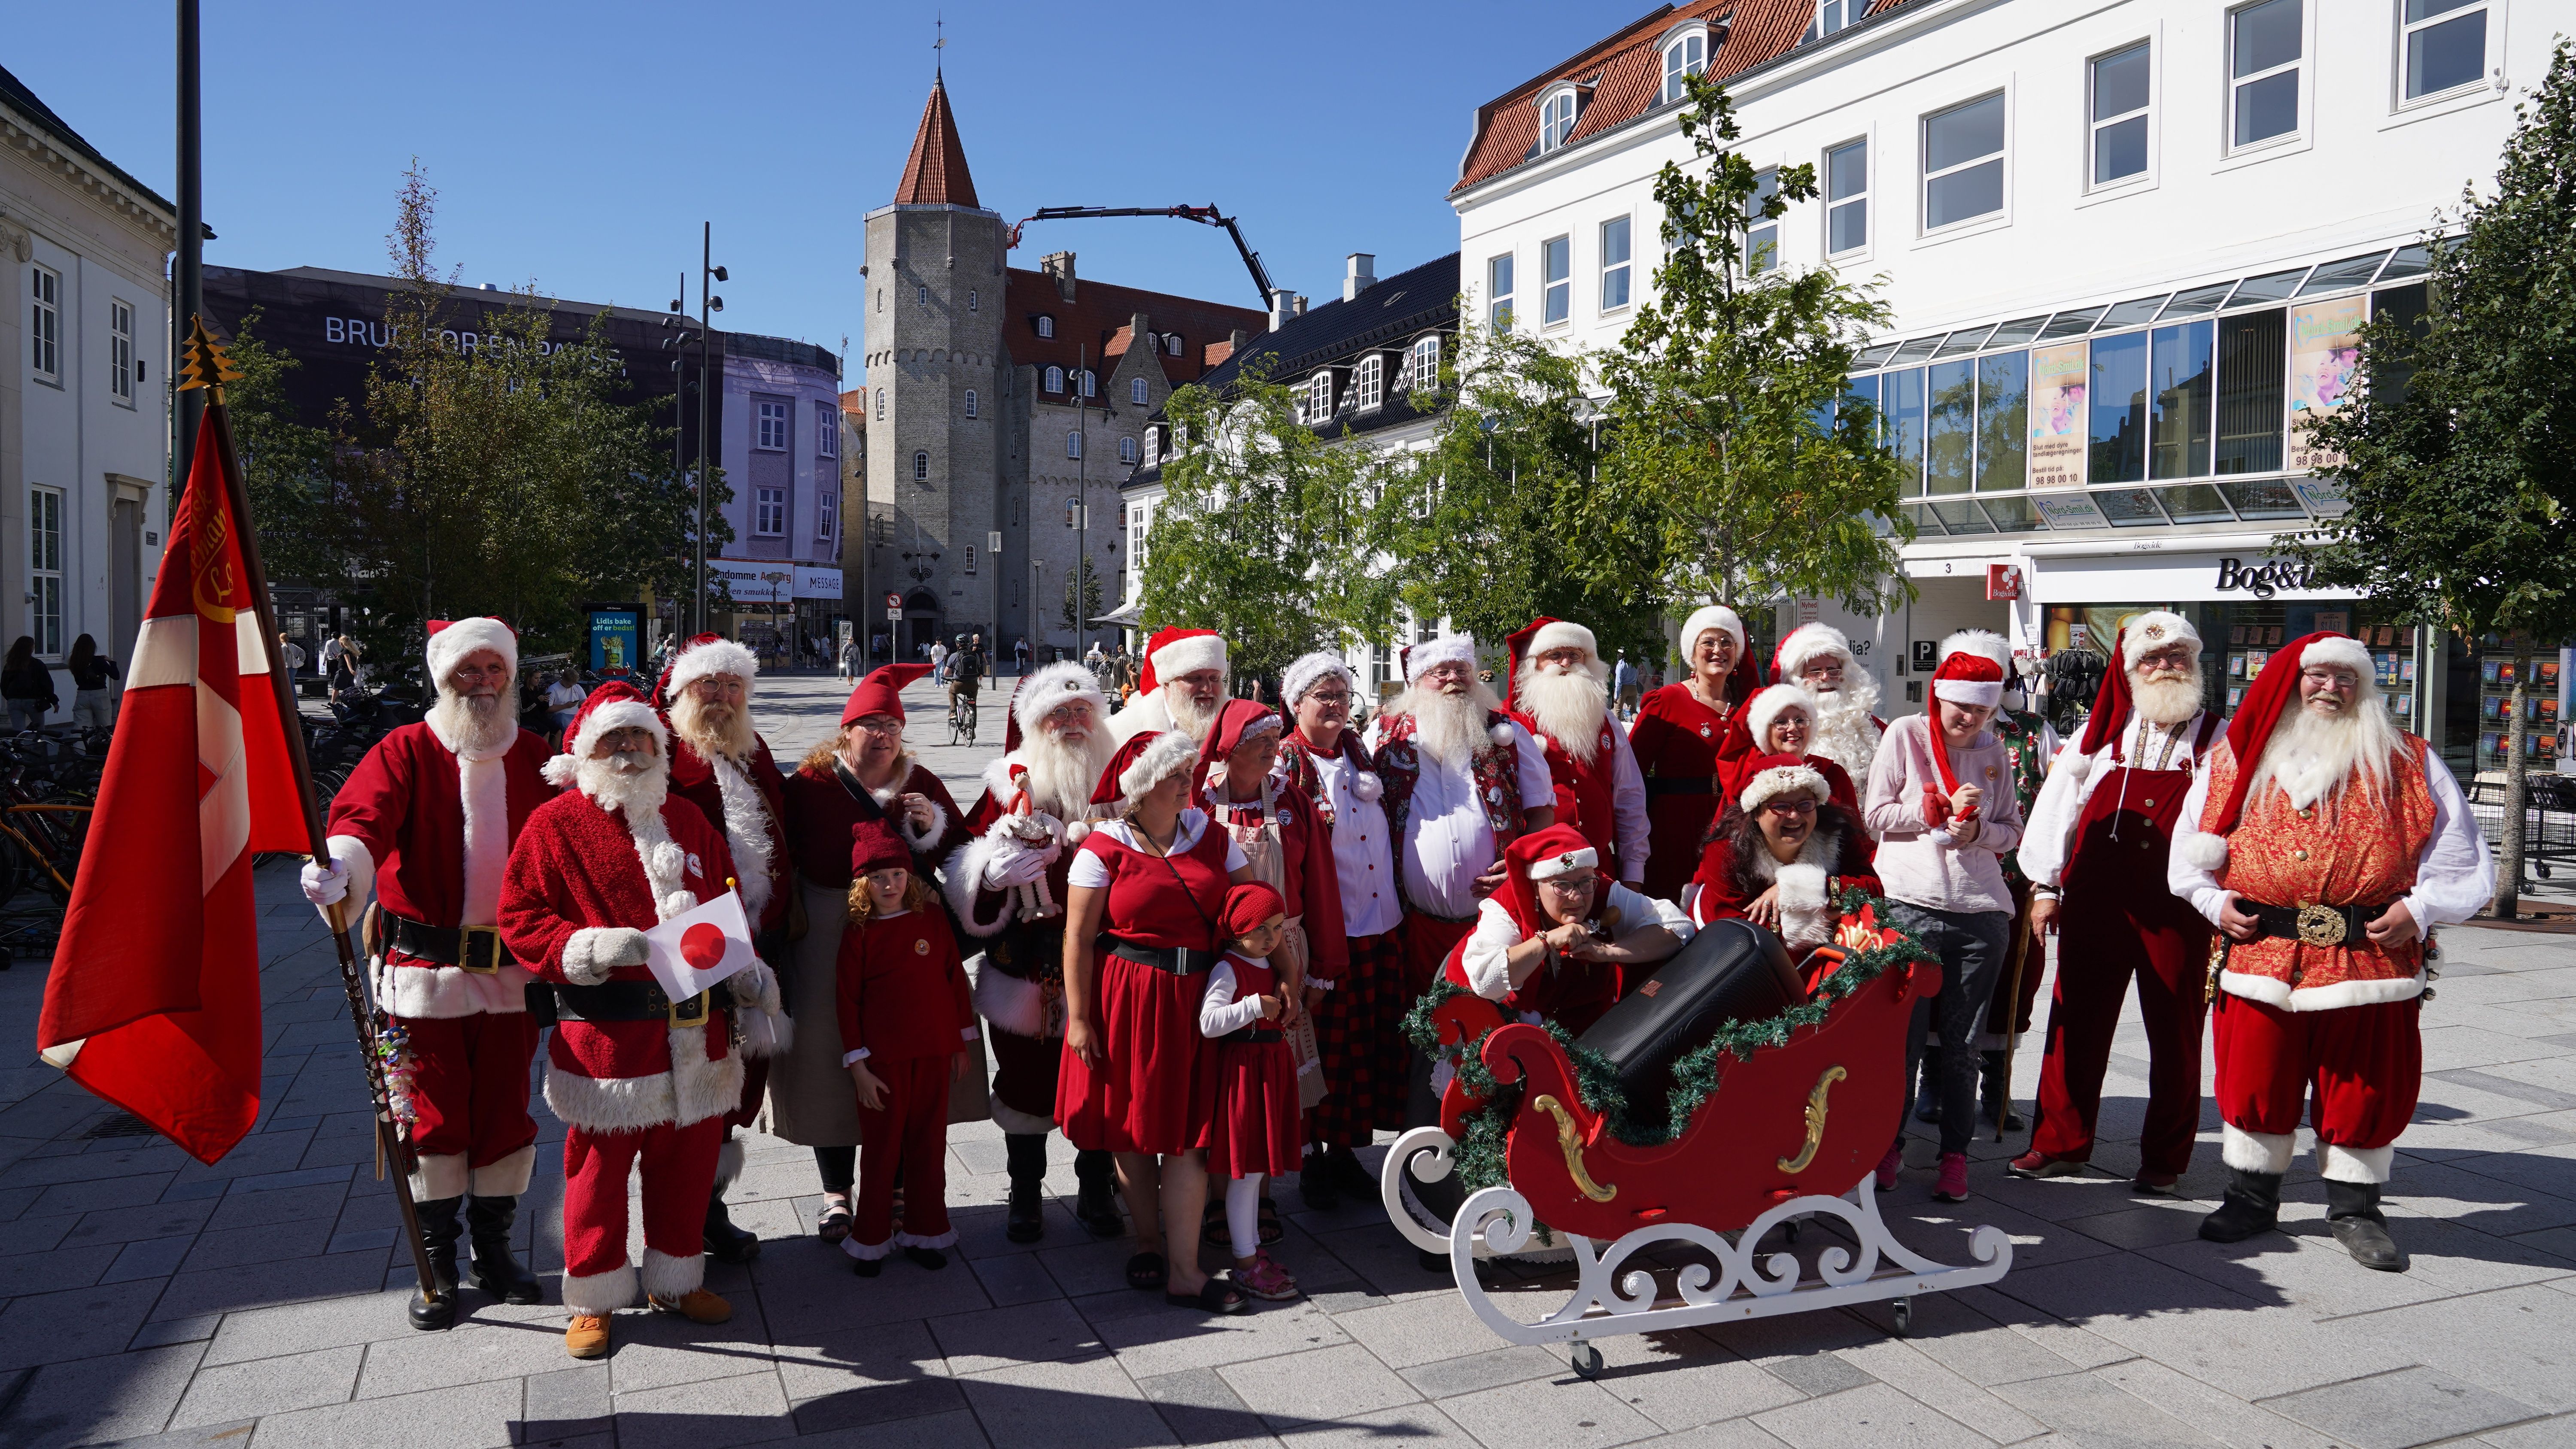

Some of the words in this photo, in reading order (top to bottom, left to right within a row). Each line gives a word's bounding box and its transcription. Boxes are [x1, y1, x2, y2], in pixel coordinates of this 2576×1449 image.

[2039, 358, 2084, 375] Nord-Smil.dk
[2033, 448, 2083, 458] tandlægeregninger.
[2297, 456, 2307, 465] 98
[2311, 455, 2323, 464] 98
[2326, 453, 2338, 463] 00
[2036, 476, 2044, 485] 98
[2047, 476, 2055, 484] 98
[2058, 474, 2066, 483] 00
[2069, 473, 2078, 482] 10
[2047, 504, 2096, 515] Nord-Smil.dk
[2133, 540, 2163, 551] Bog&idé
[1946, 563, 1951, 573] 3
[713, 570, 756, 580] endomme
[810, 577, 839, 590] MESSAGE
[1993, 589, 2017, 598] Bog&idé
[1920, 643, 1931, 660] P
